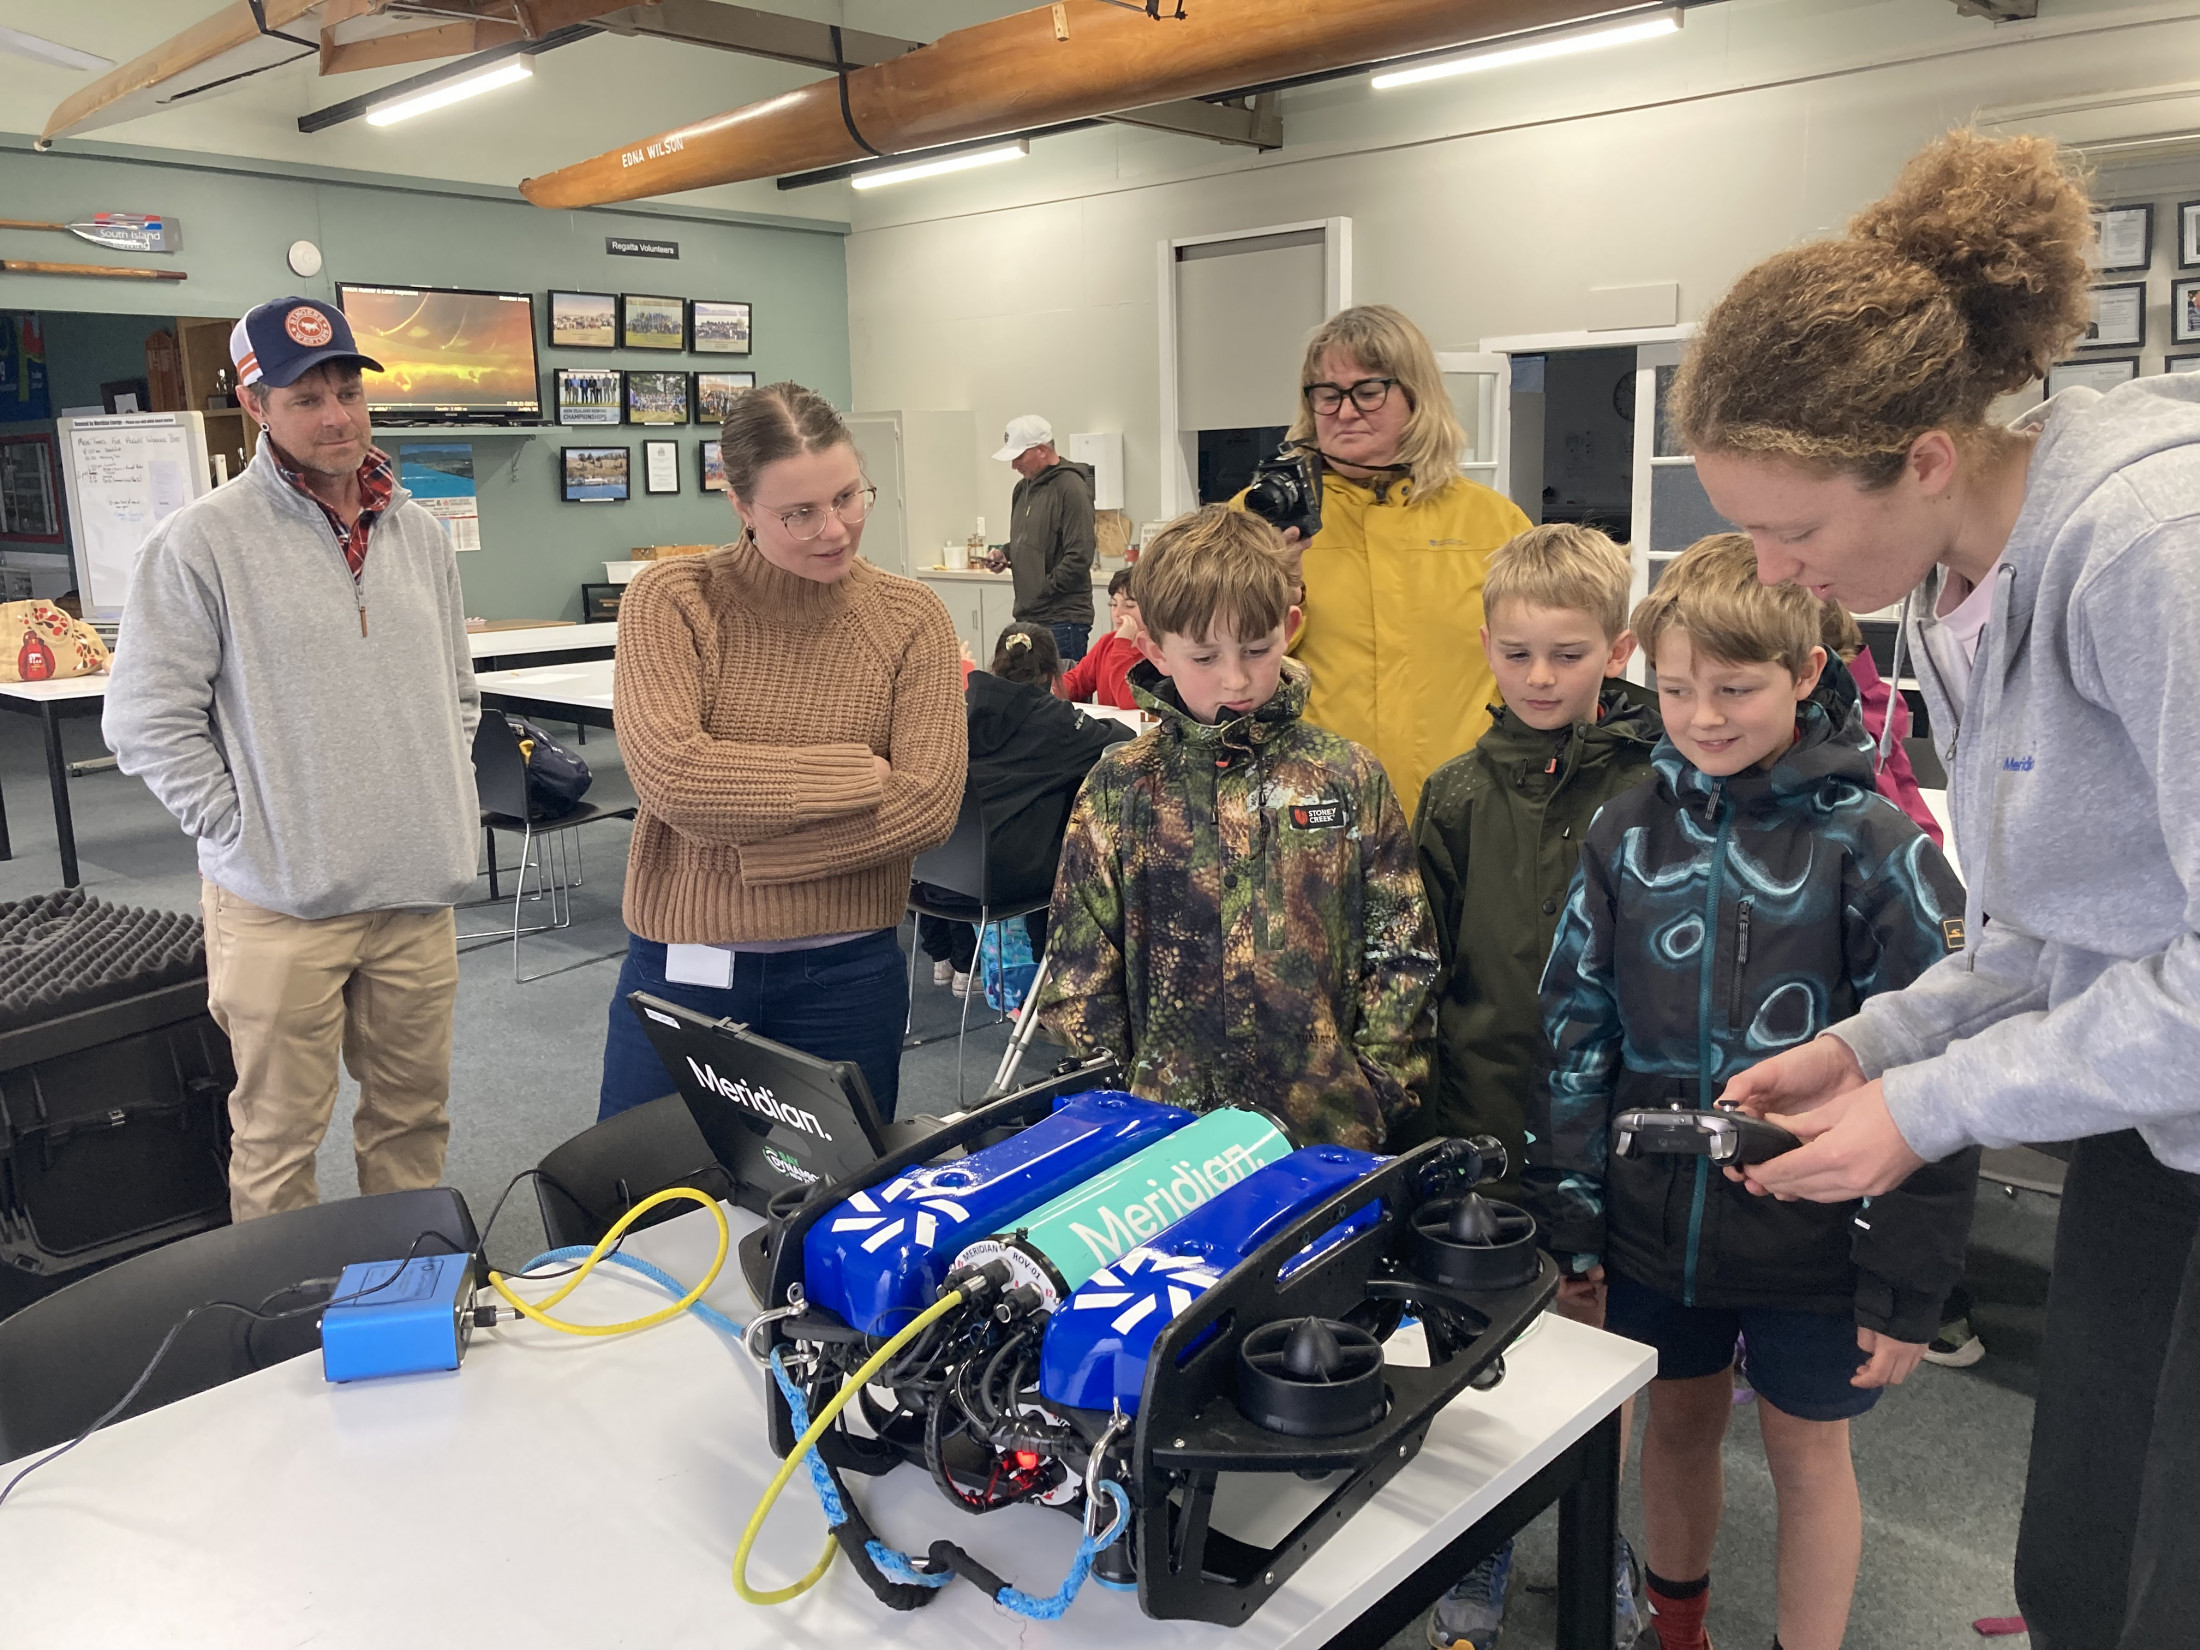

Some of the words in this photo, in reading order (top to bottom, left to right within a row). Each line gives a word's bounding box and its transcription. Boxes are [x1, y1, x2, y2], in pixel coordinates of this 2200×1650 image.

[621, 148, 645, 168] EDNA
[646, 136, 684, 160] WILSON
[99, 229, 129, 240] South
[131, 231, 161, 241] Island
[612, 241, 639, 252] Regatta
[639, 244, 674, 254] Volunteers
[289, 309, 325, 324] RINGERS
[295, 329, 330, 345] WESTERN
[1308, 807, 1337, 817] STONEY
[1309, 815, 1334, 824] CREEK
[686, 1055, 833, 1142] Meridian.
[770, 1155, 820, 1182] DYNAMIC
[962, 1243, 999, 1262] MERIDIAN
[1012, 1252, 1041, 1280] ROV-01
[1045, 1288, 1053, 1297] E2
